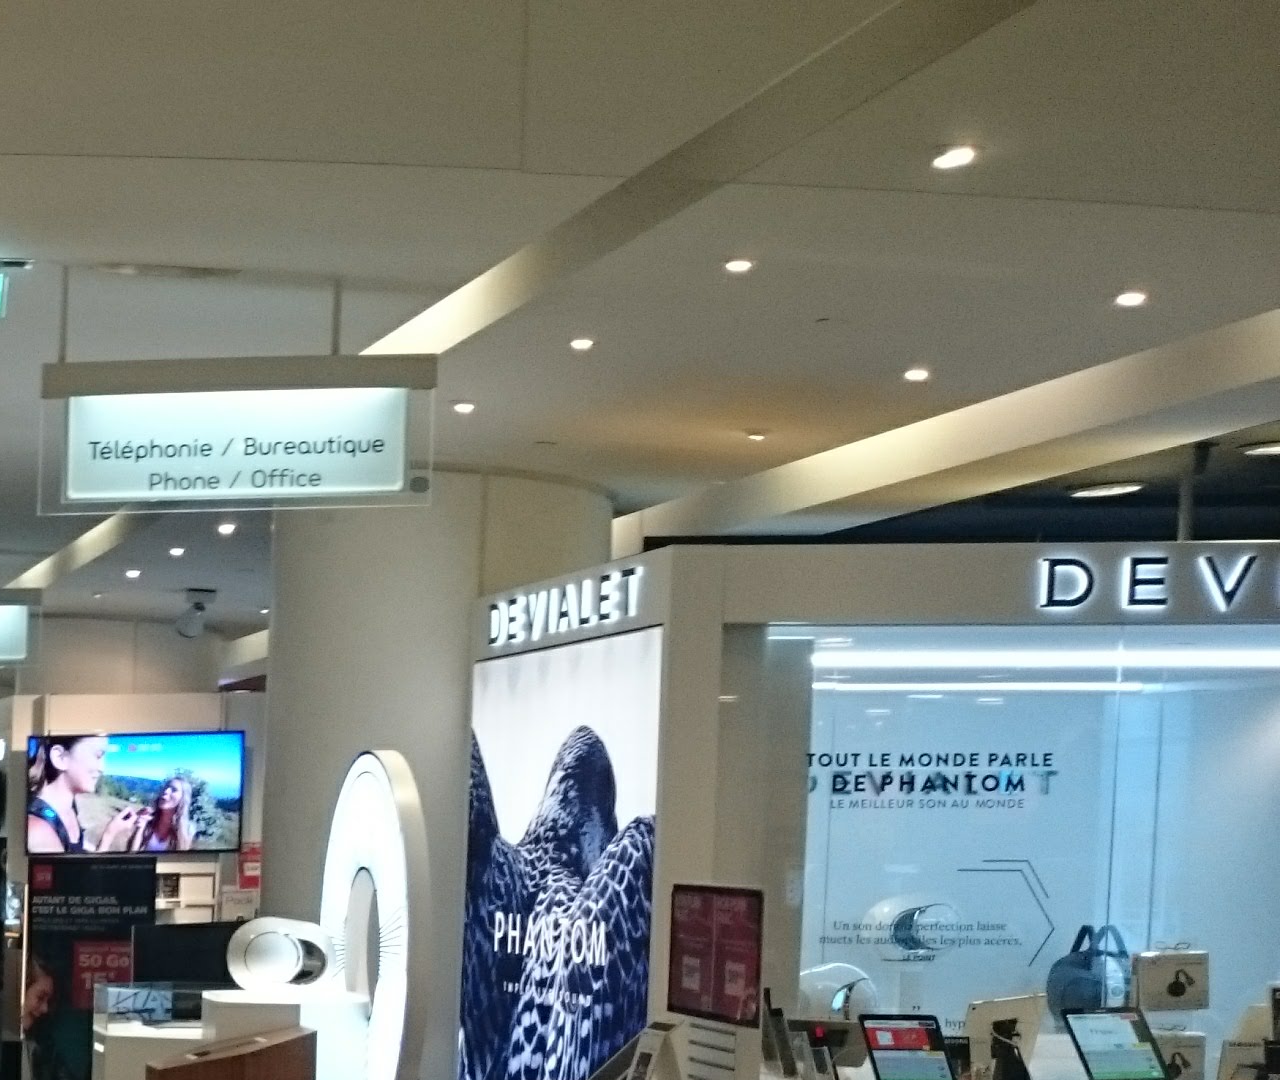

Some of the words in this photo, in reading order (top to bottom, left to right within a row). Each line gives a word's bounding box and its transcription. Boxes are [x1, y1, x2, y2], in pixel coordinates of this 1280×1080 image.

[88, 439, 212, 463] Téléphonie
[222, 438, 235, 456] /
[243, 435, 385, 459] Bureautique
[148, 472, 220, 491] Phone
[229, 471, 241, 489] /
[251, 468, 322, 489] Office
[488, 566, 644, 646] DEVIALET
[807, 753, 861, 767] TOUT
[868, 753, 891, 767] LE
[899, 753, 980, 767] MONDE
[988, 753, 1053, 767] PARLE
[832, 774, 867, 793] DE
[880, 773, 1025, 793] PHANTOM
[830, 799, 845, 809] LE
[848, 799, 914, 809] MEILLEUR
[919, 799, 947, 809] SON
[951, 799, 970, 809] AU
[975, 799, 1025, 809] MONDE
[123, 905, 148, 915] PLAN
[833, 920, 855, 931] Un
[858, 922, 876, 931] son
[916, 921, 973, 933] perfection
[976, 921, 1007, 931] laisse
[494, 911, 607, 966] PHANTOM
[819, 936, 853, 945] muets
[857, 934, 872, 945] les
[874, 934, 937, 947] audiiles
[940, 934, 954, 945] les
[958, 934, 981, 947] plus
[79, 954, 102, 967] 50
[106, 954, 129, 967] Go
